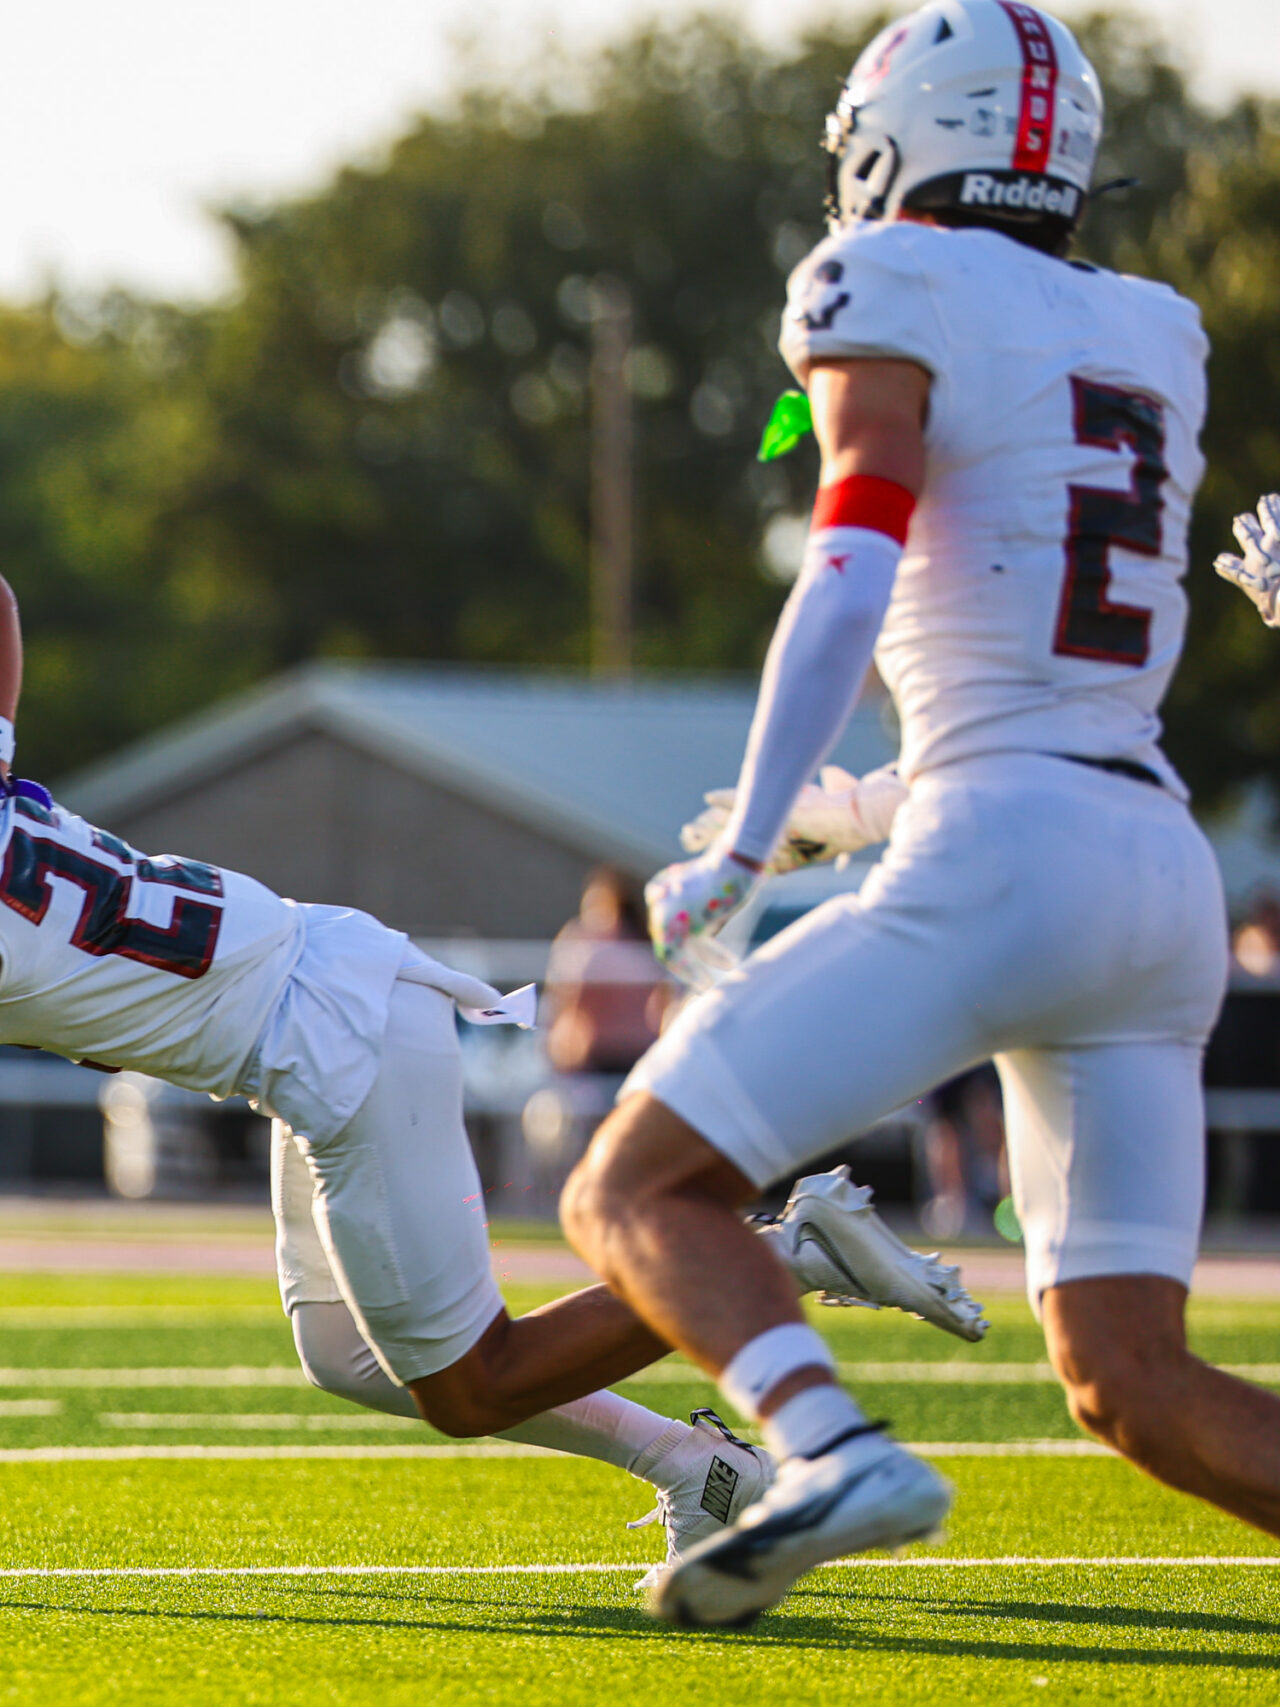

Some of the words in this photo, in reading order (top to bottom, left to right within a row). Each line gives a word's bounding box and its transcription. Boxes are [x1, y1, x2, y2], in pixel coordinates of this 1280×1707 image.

[960, 174, 1078, 217] Riddell
[1052, 374, 1171, 667] 2
[701, 1456, 738, 1523] NIKE
